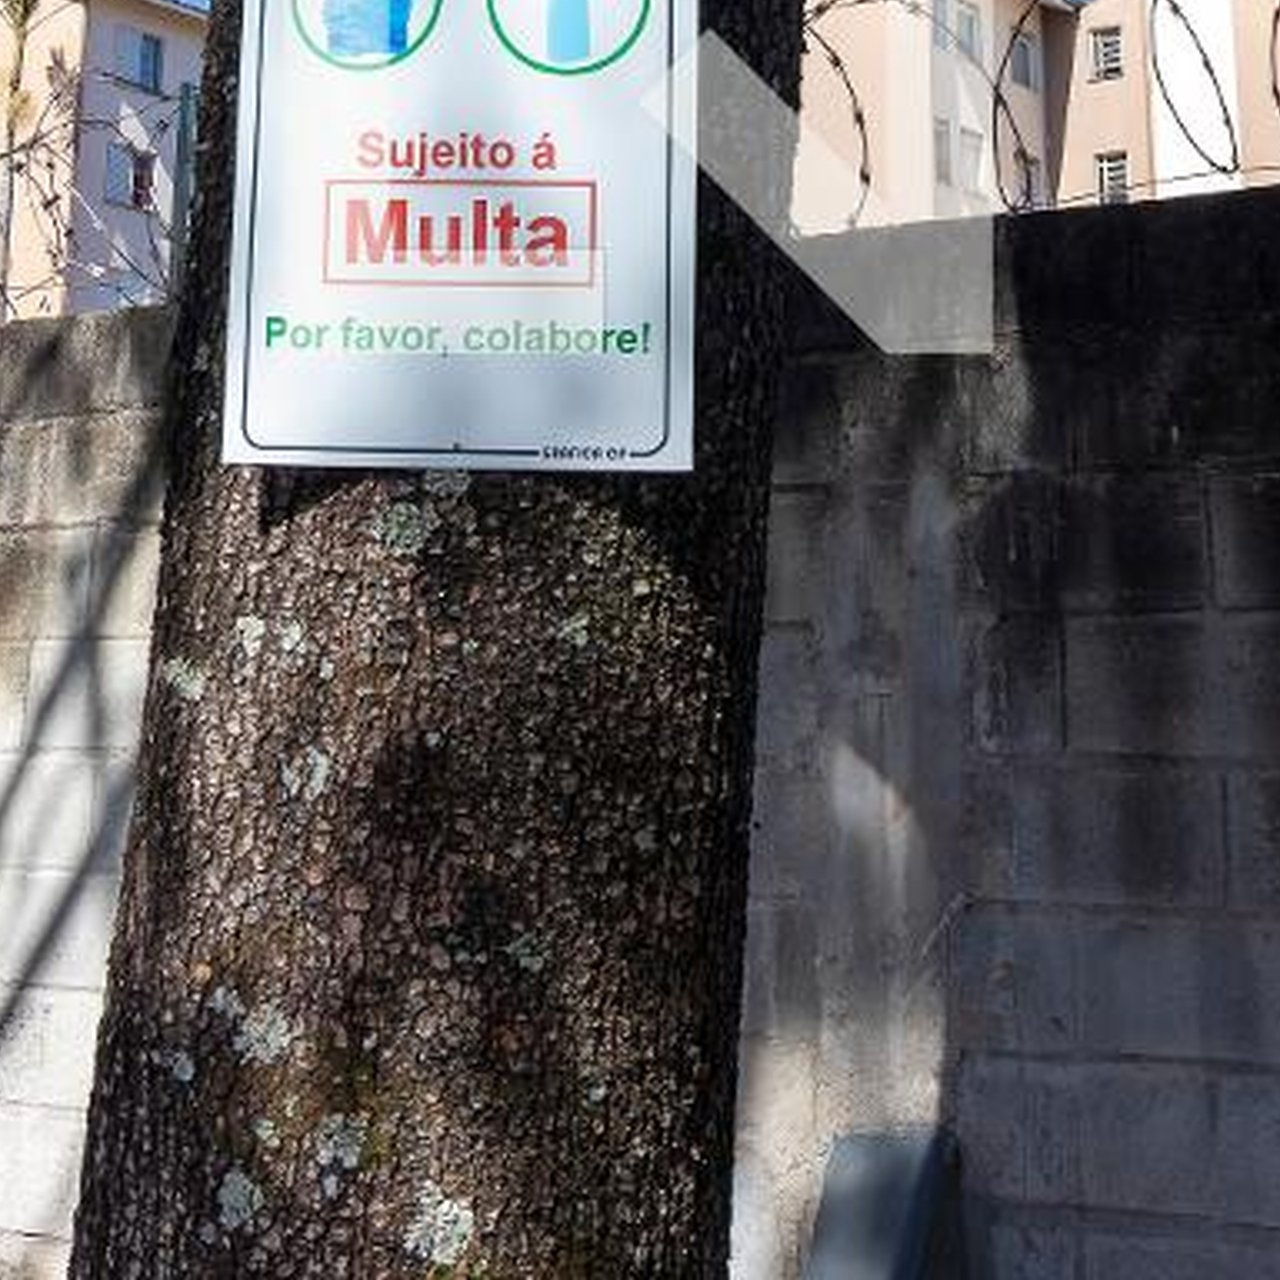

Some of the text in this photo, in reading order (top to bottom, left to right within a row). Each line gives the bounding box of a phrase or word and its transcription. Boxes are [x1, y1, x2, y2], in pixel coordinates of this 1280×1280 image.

[357, 132, 558, 177] Sujeito á
[344, 198, 569, 266] Multa
[265, 316, 332, 350] Por
[463, 320, 651, 354] colabore!
